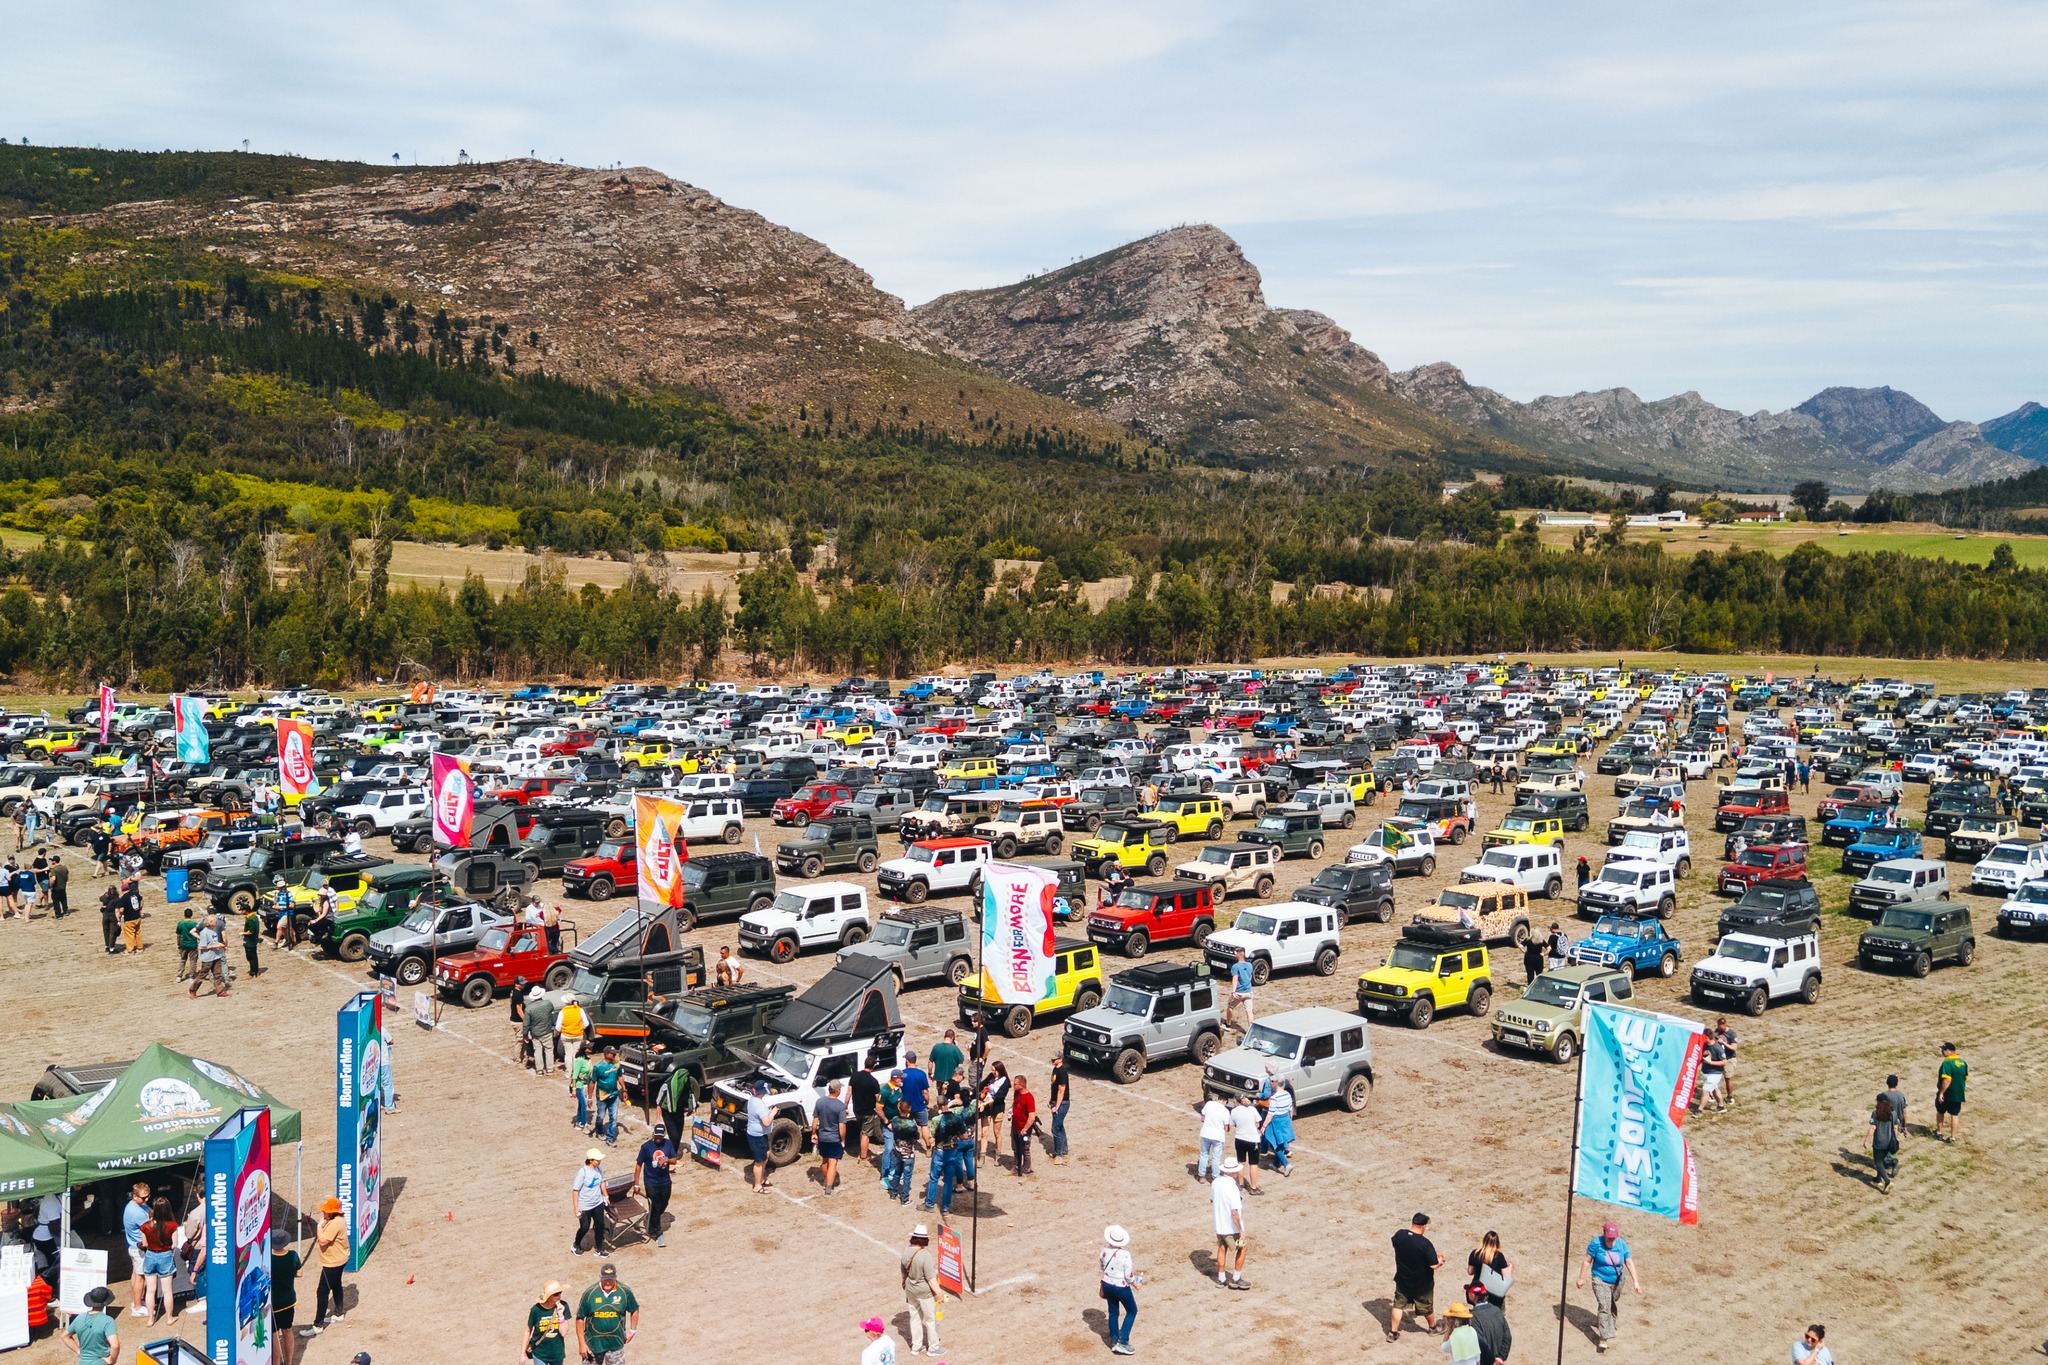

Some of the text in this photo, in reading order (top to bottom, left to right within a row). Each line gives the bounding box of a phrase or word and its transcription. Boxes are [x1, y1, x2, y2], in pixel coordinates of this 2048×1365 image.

[1009, 882, 1032, 993] BORN FOR MORE
[339, 1038, 353, 1108] #BornForMore
[1613, 1015, 1659, 1206] WELCOME
[1674, 1044, 1701, 1110] #BornForMore
[143, 1116, 221, 1134] HOEDSPRUIT
[211, 1172, 228, 1265] #BornForMore
